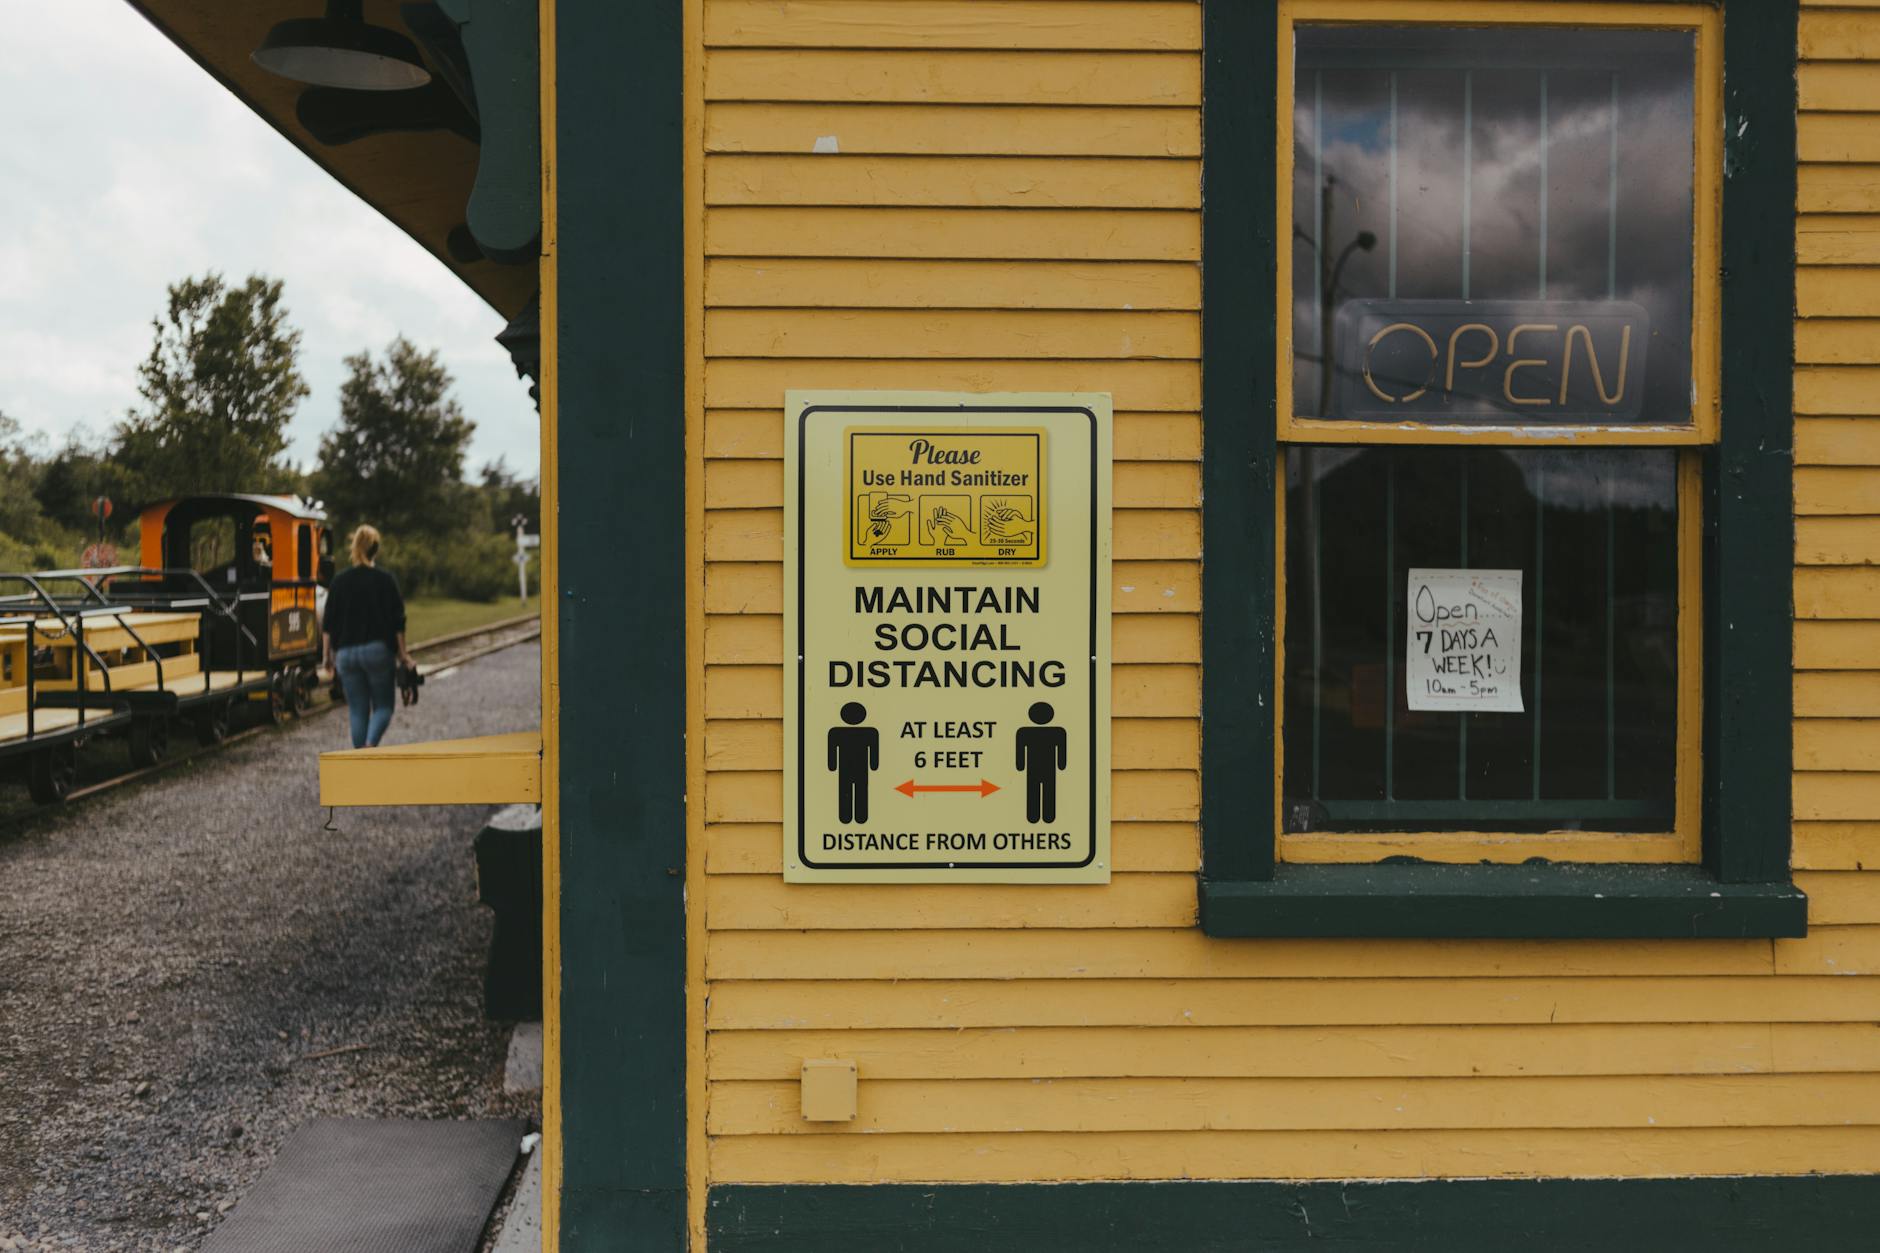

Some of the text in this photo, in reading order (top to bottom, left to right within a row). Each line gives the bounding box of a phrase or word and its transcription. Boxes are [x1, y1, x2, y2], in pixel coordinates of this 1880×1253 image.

[1361, 322, 1631, 405] OPEN
[909, 439, 981, 465] Please
[863, 470, 1029, 486] Use Hand Sanitizer
[870, 548, 898, 556] APPLY
[936, 548, 955, 556] RUB
[998, 548, 1017, 556] DRY
[855, 586, 1040, 614] MAINTAIN
[874, 623, 1021, 651] SOCIAL
[1416, 627, 1499, 654] 7 DAYS A
[828, 660, 1066, 688] DISTANCING
[1432, 654, 1492, 679] WEEK!
[1426, 679, 1456, 695] 10am
[1470, 680, 1498, 699] 5pm
[900, 721, 997, 739] AT LEAST
[914, 751, 984, 769] 6 FEET
[823, 832, 1072, 851] DISTANCE FROM OTHERS
